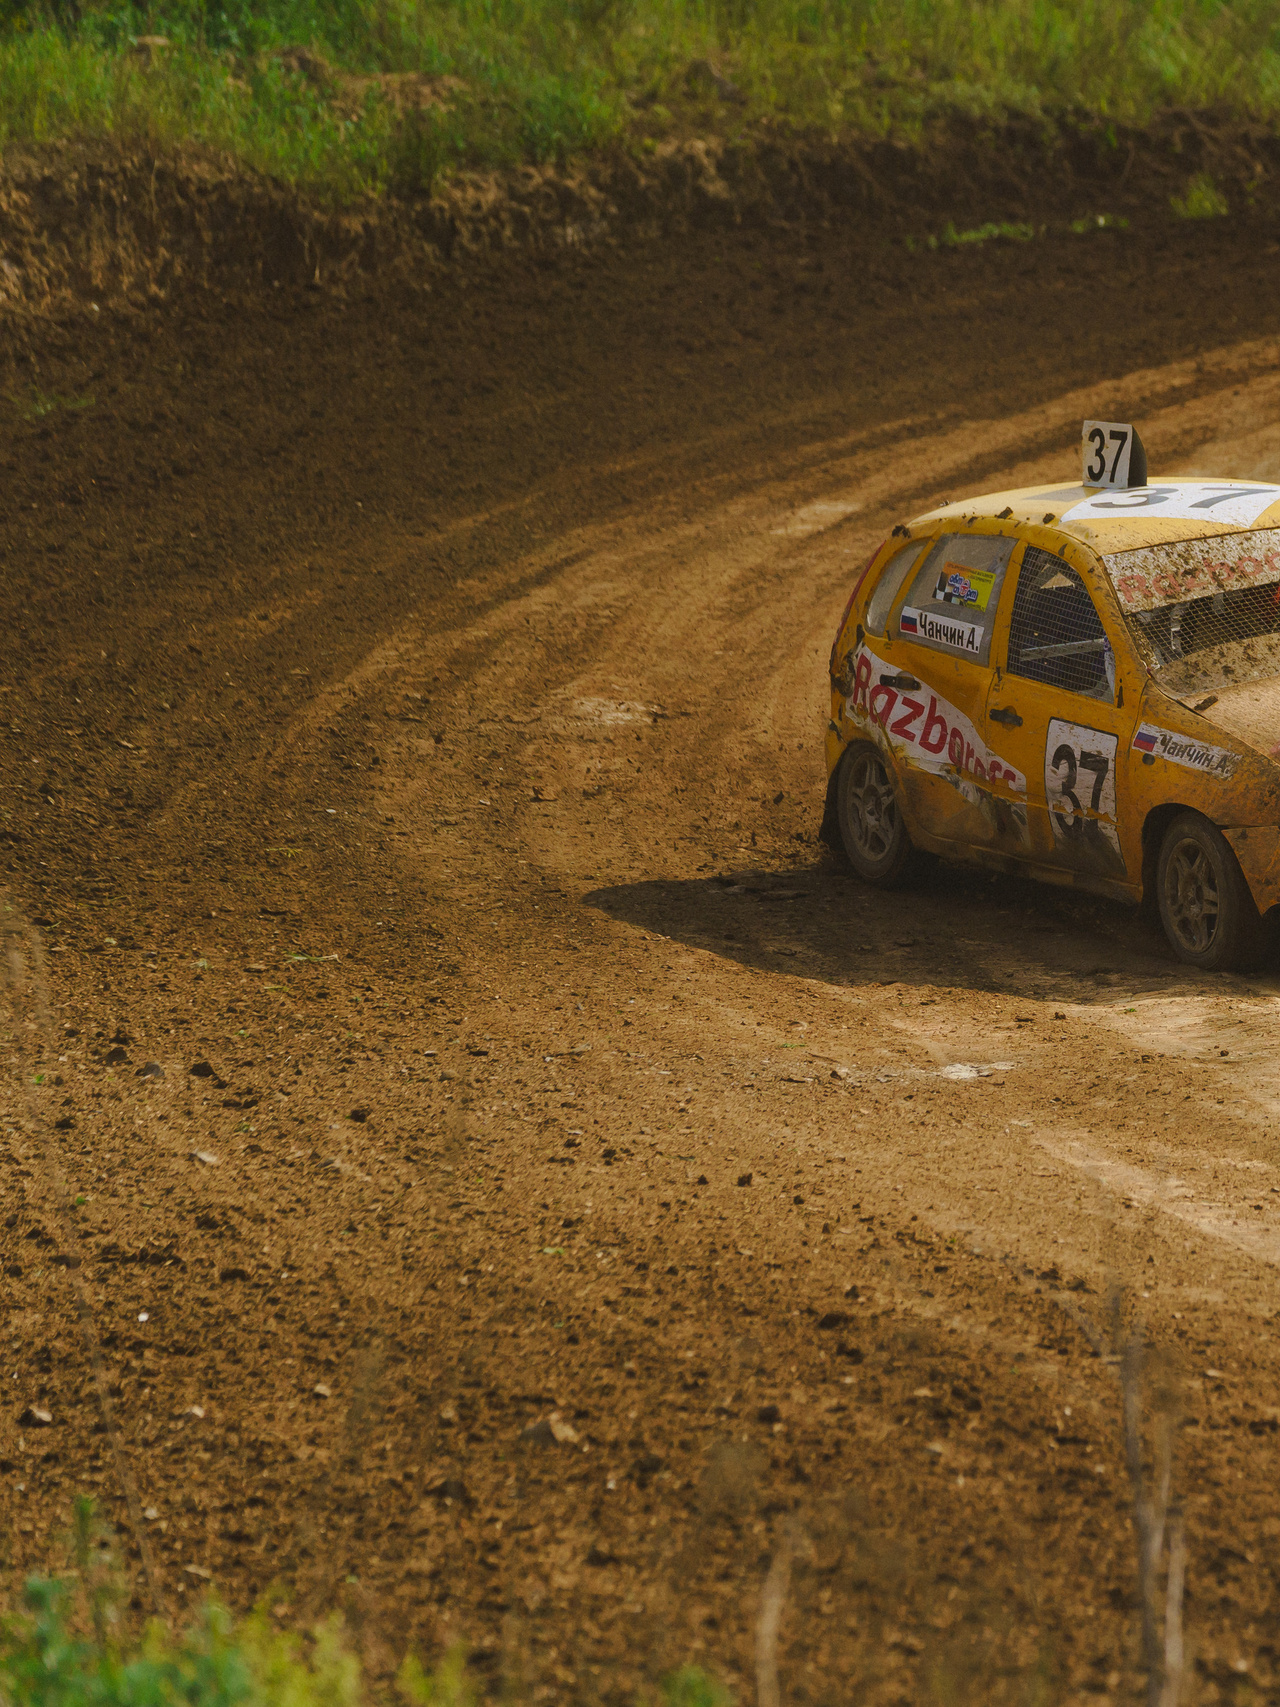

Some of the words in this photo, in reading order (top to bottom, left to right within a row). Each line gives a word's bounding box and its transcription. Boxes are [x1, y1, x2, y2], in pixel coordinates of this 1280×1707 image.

[1087, 427, 1128, 484] 37
[1090, 487, 1279, 509] 37
[919, 612, 965, 647] Чанчин
[965, 626, 979, 651] А.
[1160, 733, 1214, 768] Чанчин
[1052, 743, 1109, 836] 37
